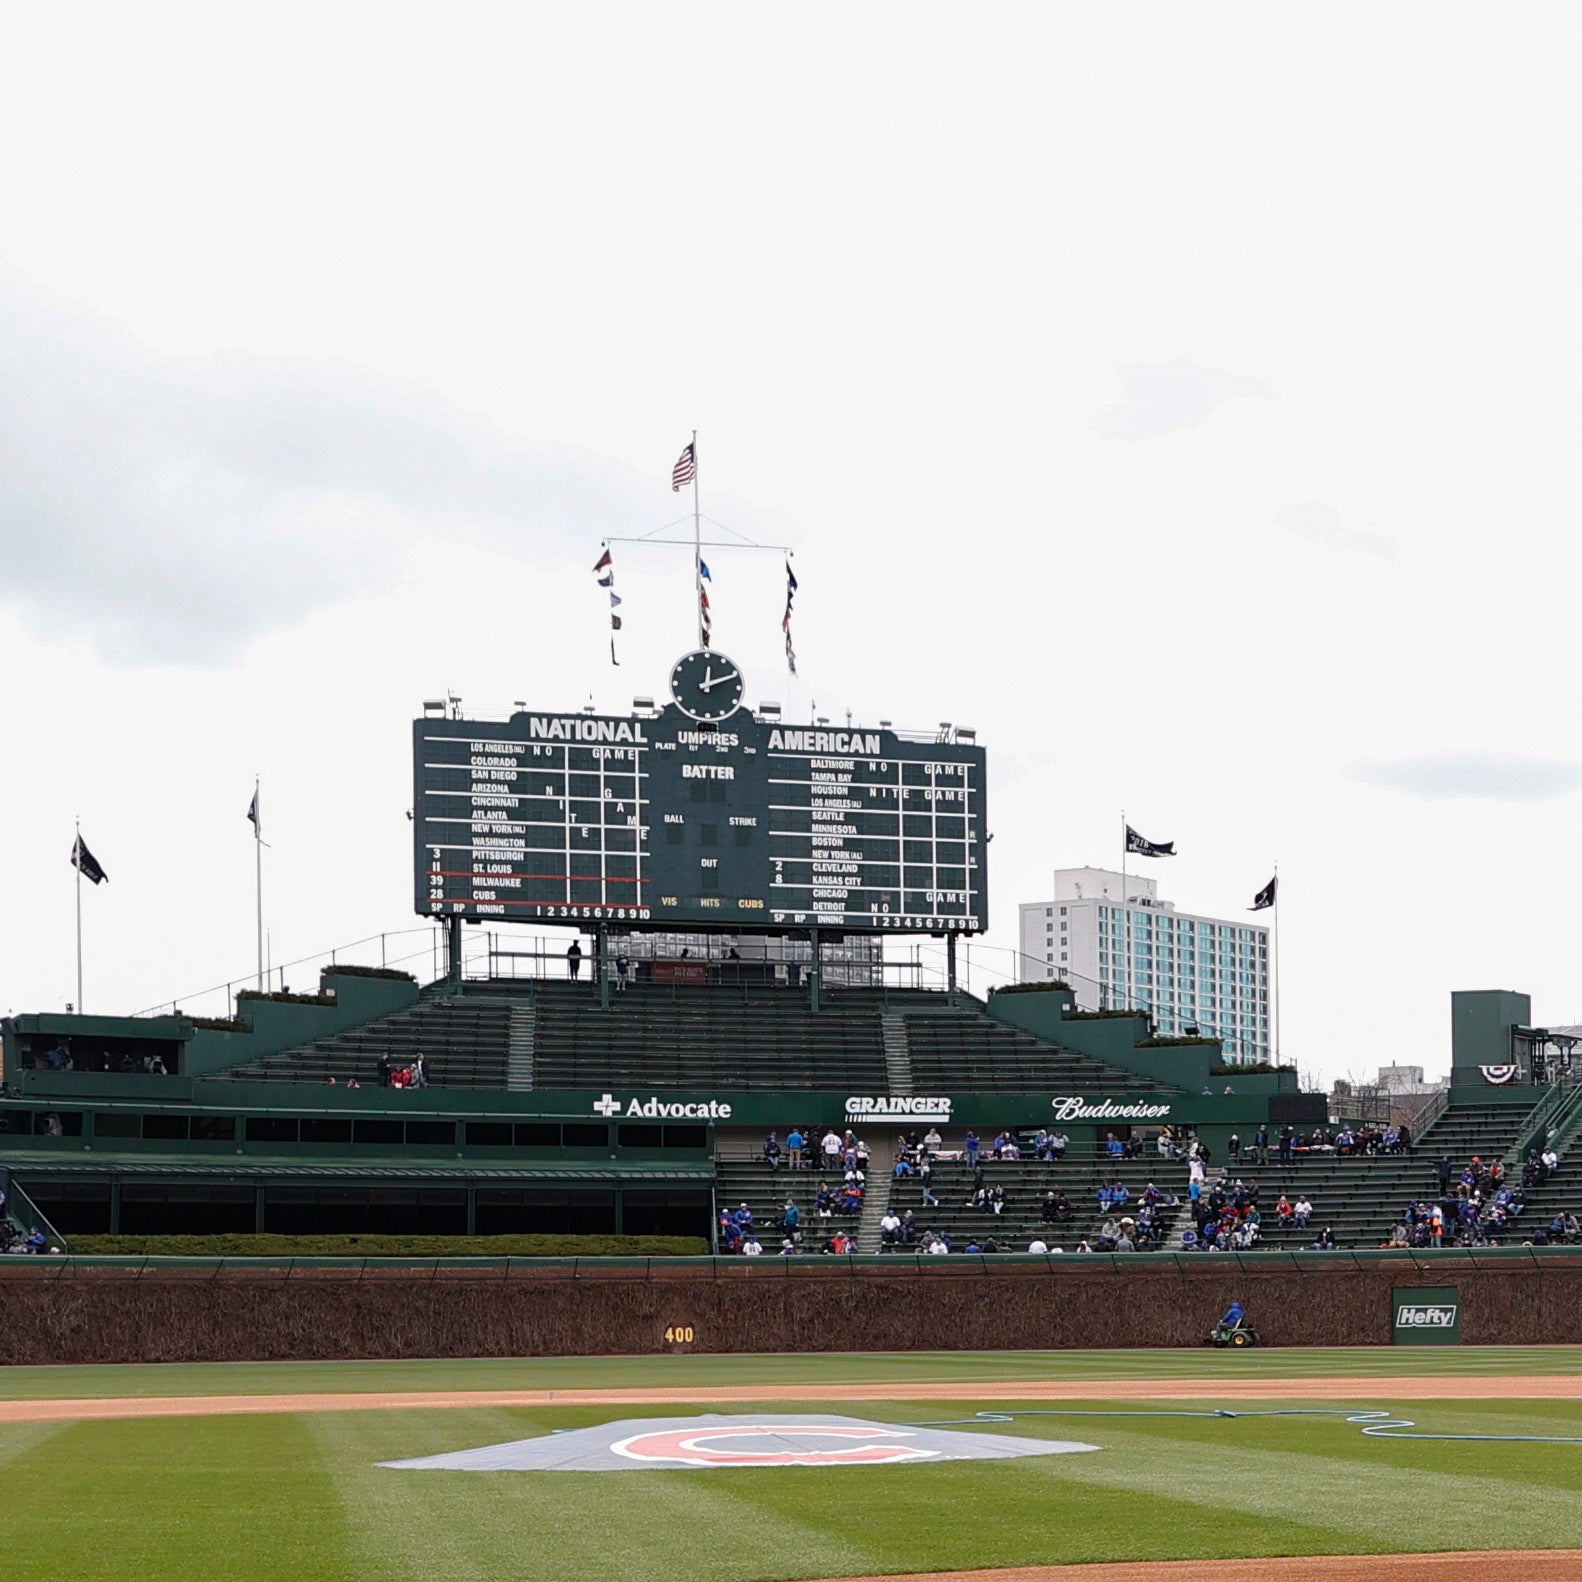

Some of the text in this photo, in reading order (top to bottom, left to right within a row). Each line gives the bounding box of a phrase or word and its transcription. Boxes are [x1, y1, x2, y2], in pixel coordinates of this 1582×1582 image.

[530, 717, 648, 743] NATIONAL
[677, 731, 739, 747] UMPIRES
[767, 729, 881, 754] AMERICAN
[470, 743, 484, 753] LOS
[485, 743, 513, 754] ANGELES
[592, 748, 635, 760] GAME
[655, 742, 677, 751] PLATE
[470, 757, 517, 768] COLORADO
[811, 759, 854, 770] BALTIMORE
[924, 765, 964, 776] GAME
[471, 770, 518, 781] SAN DIEGO
[682, 764, 735, 780] BATTER
[811, 772, 852, 783] TAMPA BAY
[471, 783, 509, 794] ARIZONA
[811, 785, 848, 796] HOUSTON
[471, 797, 519, 808] CINCINNATI
[811, 798, 823, 807] LOS
[471, 810, 508, 821] ATLANTA
[664, 814, 757, 827] BALL STRIKE
[812, 811, 844, 821] SEATTLE
[471, 824, 513, 834] NEW YORK
[811, 824, 857, 834] MINNESOTA
[472, 837, 525, 848] WASHINGTON
[812, 837, 843, 847] BOSTON
[433, 848, 524, 861] 3 PITTSBURGH
[812, 850, 850, 860] NEW YORK
[701, 858, 718, 868] OUT
[775, 861, 858, 873] 2 CLEVELAND
[487, 864, 512, 874] LOUIS
[430, 875, 522, 888] 39 MILWAUKEE
[775, 874, 862, 886] 8 KANSAS CITY
[430, 889, 496, 900] 28 CUBS
[813, 889, 848, 899] CHICAGO
[661, 896, 678, 906] VIS
[700, 898, 720, 908] HITS
[738, 899, 764, 908] CUBS
[431, 903, 505, 914] SP RP INNING
[813, 902, 846, 912] DETROIT
[774, 913, 785, 922] SP
[795, 914, 806, 923] RP
[627, 1098, 731, 1118] Advocate
[844, 1097, 952, 1113] GRAINGER
[1051, 1097, 1171, 1121] Budweiser
[1400, 1308, 1452, 1325] Hefty
[664, 1327, 693, 1342] 400
